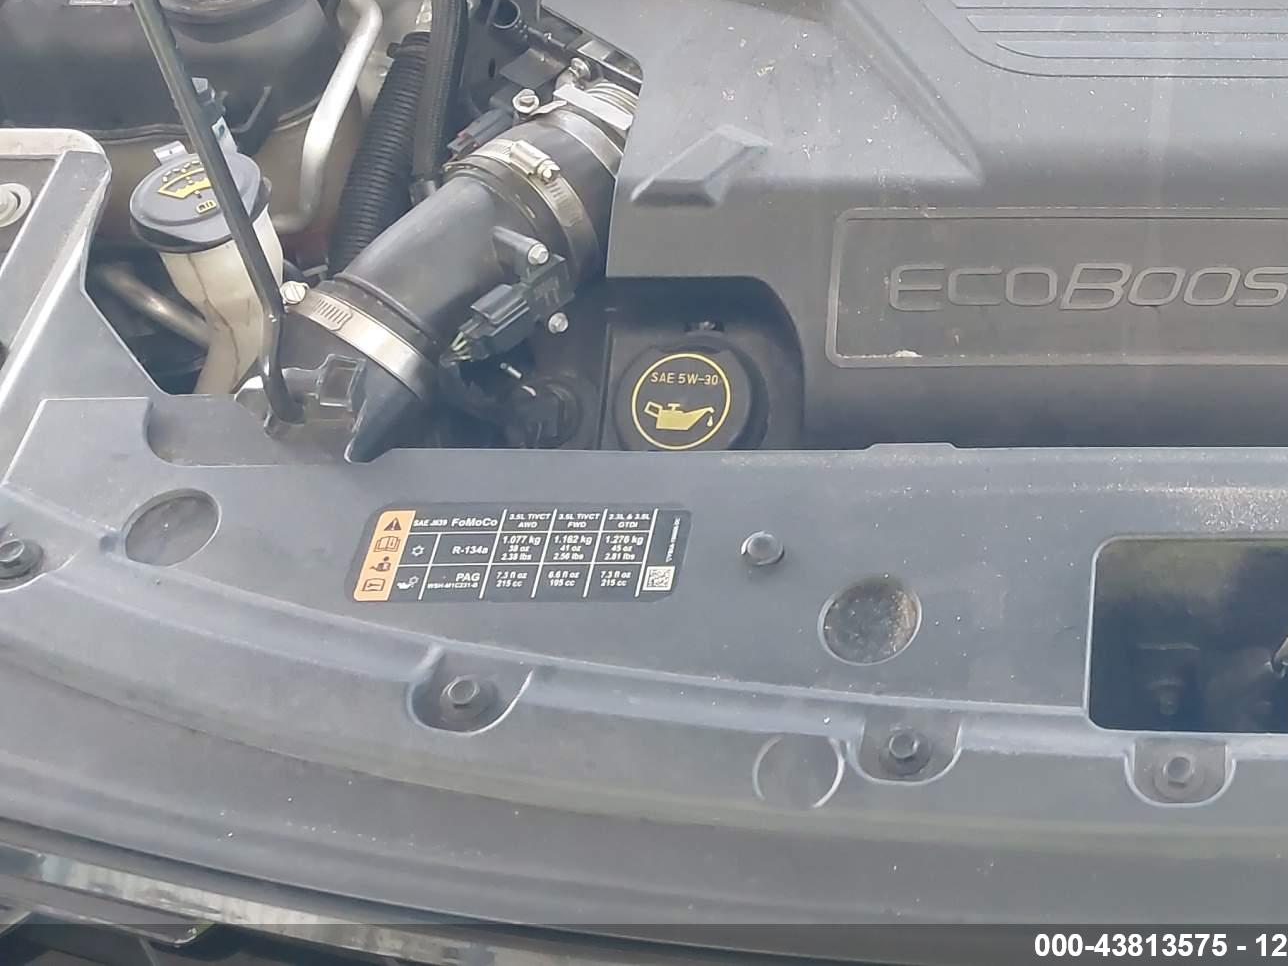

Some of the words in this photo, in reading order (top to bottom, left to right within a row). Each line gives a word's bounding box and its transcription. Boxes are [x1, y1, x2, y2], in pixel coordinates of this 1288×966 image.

[650, 372, 675, 384] SAE
[678, 373, 719, 386] 5W-30
[451, 518, 498, 527] FoMoCo
[502, 536, 528, 544] 1.077
[528, 535, 542, 546] kg
[554, 535, 580, 544] 1.162
[580, 535, 592, 546] kg
[631, 536, 644, 546] kg
[452, 546, 489, 554] R-134a
[455, 572, 480, 582] PAG
[600, 570, 613, 578] 7.3
